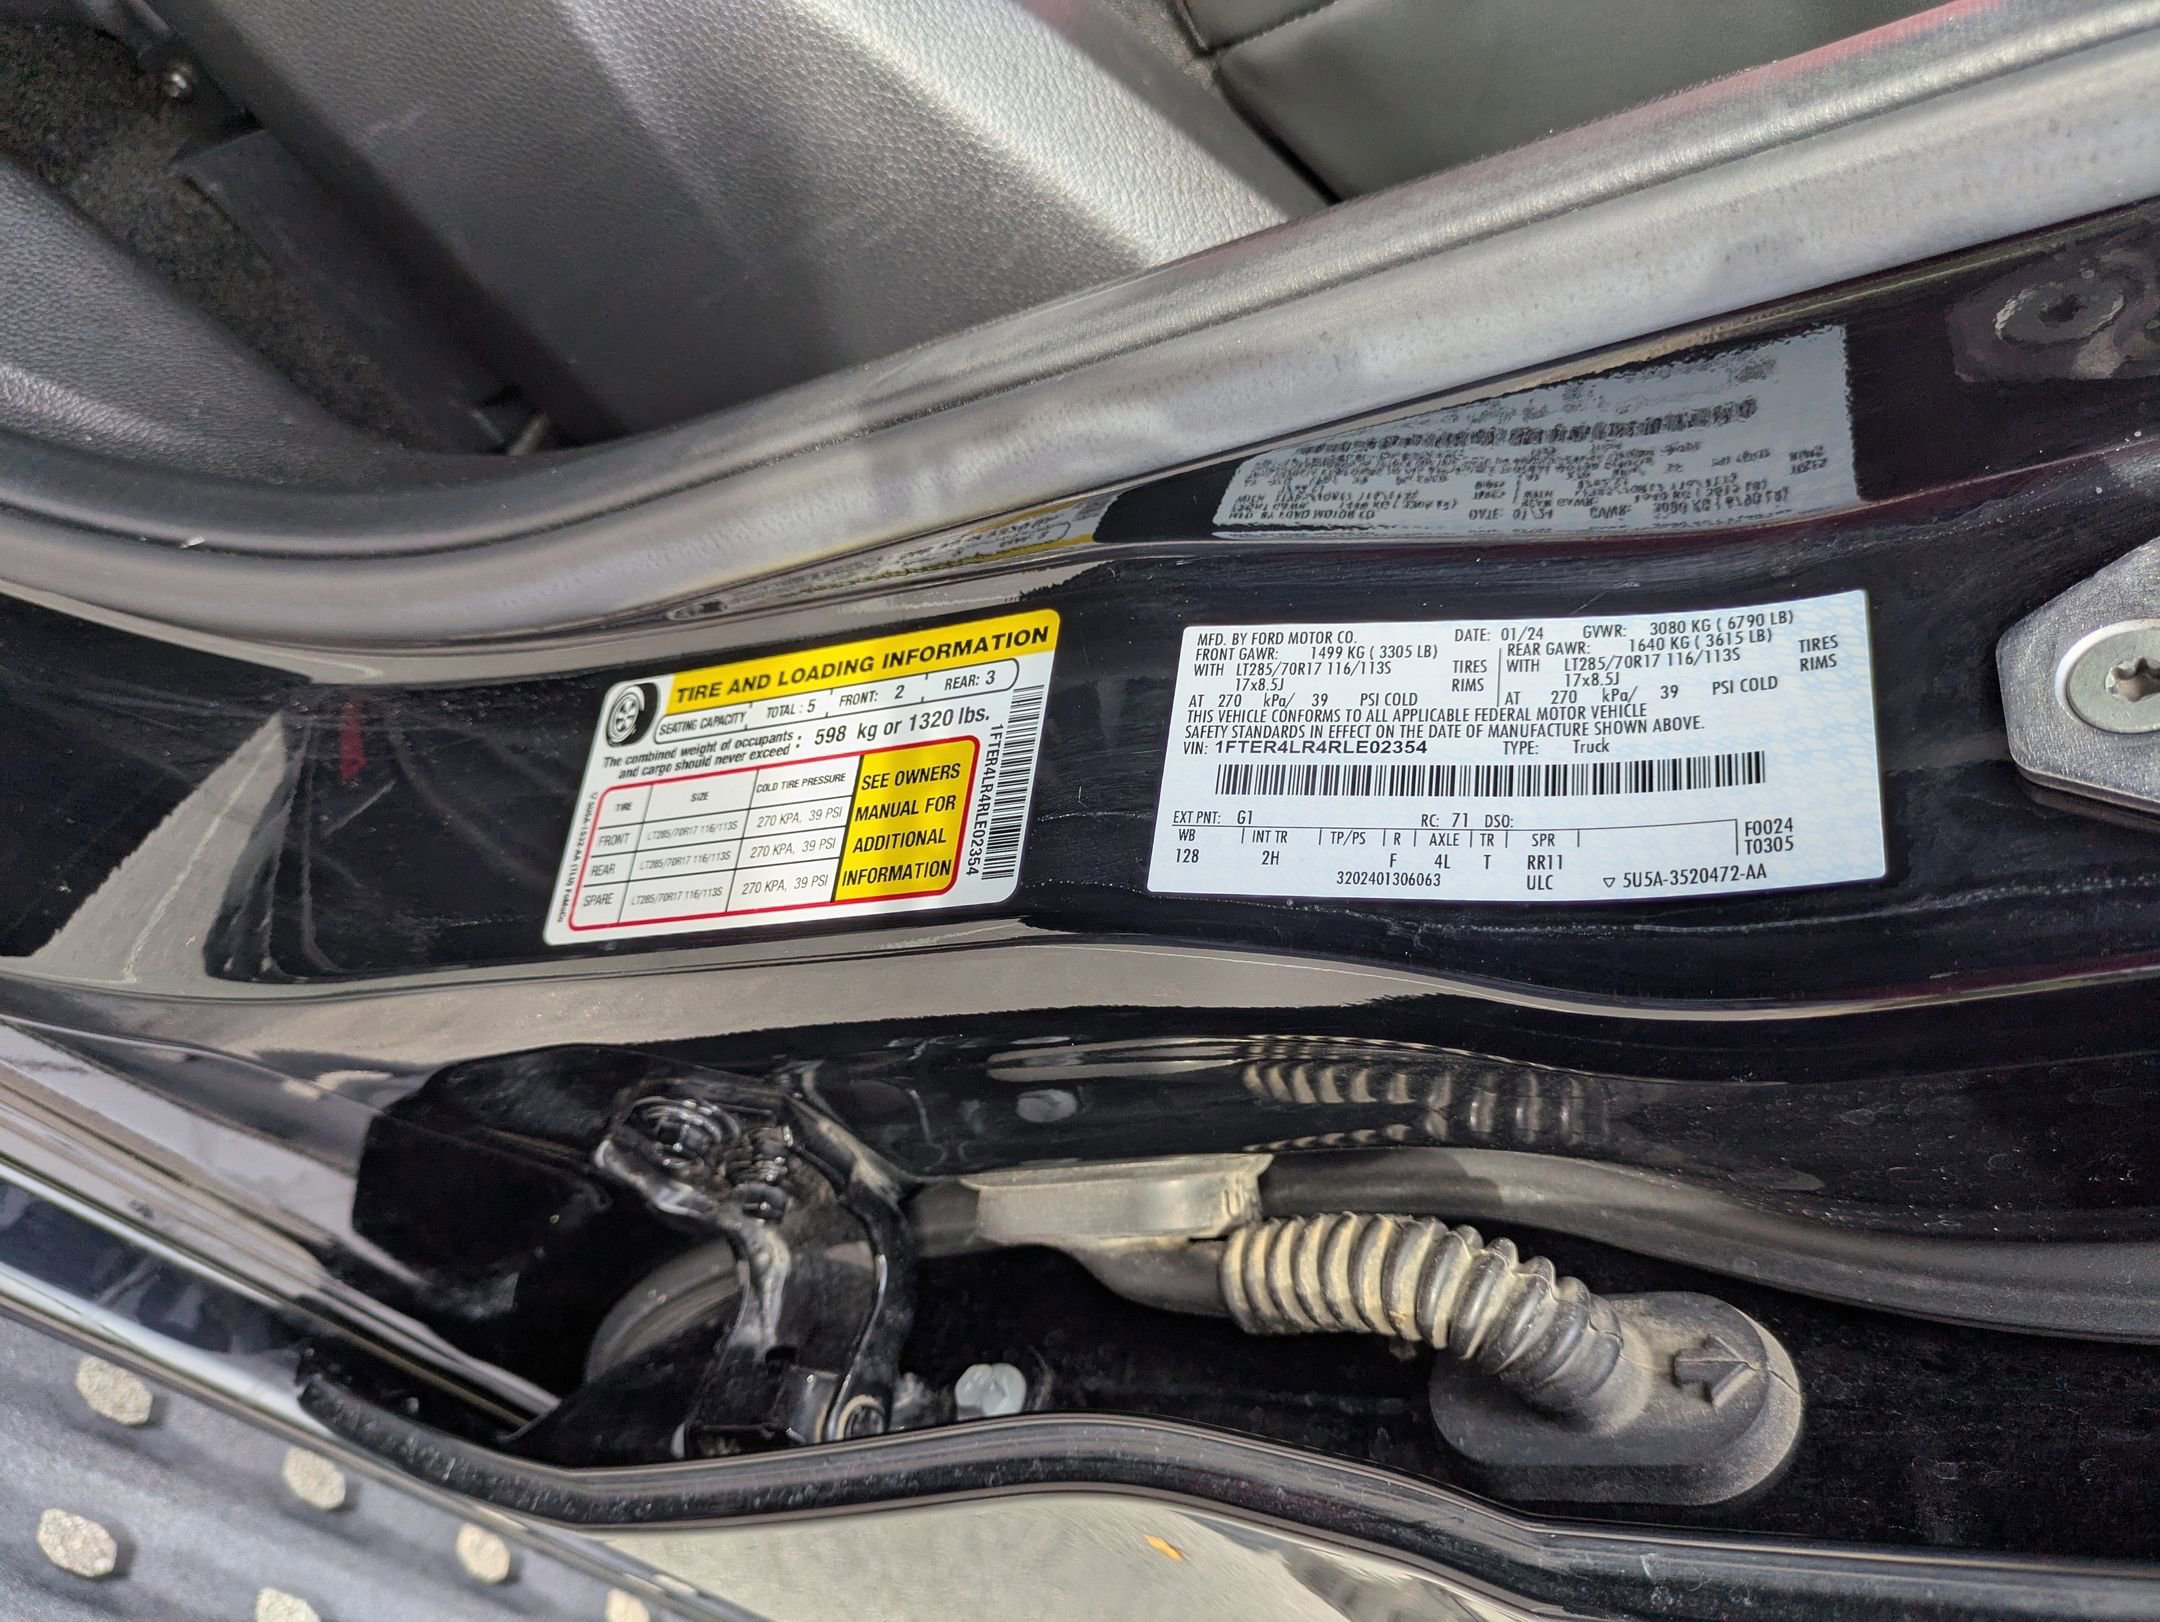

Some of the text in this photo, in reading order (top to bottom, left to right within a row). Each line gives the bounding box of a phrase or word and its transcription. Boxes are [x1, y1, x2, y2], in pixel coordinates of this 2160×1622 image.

[1583, 610, 1793, 639] GVWR: 3080 KG 6790 LB)
[1197, 631, 1357, 646] MFD. BY FORD MOTOR CO.
[1455, 626, 1544, 642] DATE: 01/24
[1507, 629, 1772, 656] REAR GAWR: 1640 KG 3615 LB)
[1798, 635, 1838, 653] TIRES
[1196, 645, 1437, 660] FRONT GAWR: 1499 KG 3305 LB)
[1506, 648, 1740, 673] WITH LT285/70R17 116/113S
[677, 626, 1049, 703] TIRE AND LOADING INFORMATION
[1194, 661, 1391, 676] WITH LT285/70R17 116/113S
[1453, 660, 1487, 673] TIRES
[1800, 654, 1837, 672] RIMS
[944, 671, 995, 690] REAR: 3
[1235, 679, 1284, 692] 17x8.5J
[1452, 678, 1484, 692] RIMS
[1564, 673, 1619, 687] 17x8.5J
[839, 685, 904, 707] FRONT: 2
[1504, 676, 1778, 705] AT 270 kPa/ 39 PSI COLD
[807, 700, 815, 713] 5
[1189, 692, 1418, 707] AT 270 kPa/ 39 PSI COLD
[1187, 704, 1646, 723] THIS VEHICLE CONFORMS TO ALL APPLICABLE FEDERAL MOTOR VEHICLE
[659, 711, 747, 735] SEATING CAPACITY
[814, 706, 989, 745] 598 kg or 1320 lbs.
[1185, 716, 1704, 739] SAFETY STANDARDS IN EFFECT ON THE DATE OF MANUFACTURE SHOWN ABOVE.
[604, 730, 793, 768] The combined weight of occupants
[1183, 739, 1428, 755] VIN: 1FTER4LR4RLE02354
[1503, 737, 1610, 755] TYPE: Truck
[618, 747, 789, 779] and cargo should never exceed
[757, 773, 845, 793] COLD TIRE PRESSURE
[862, 763, 960, 790] SEE OWNERS
[691, 792, 709, 801] SIZE
[966, 724, 1004, 876] 1FTER4LR4RLE02354
[616, 802, 632, 812] TIRE
[855, 795, 956, 822] MANUAL FOR
[757, 806, 843, 828] 270 KPA, 39 PSI
[1174, 810, 1252, 824] EXT PNT: G1
[1421, 813, 1468, 827] RC: 71
[701, 821, 738, 833] 116/113S
[1178, 829, 1195, 841] WB
[1745, 818, 1793, 836] F0024
[599, 833, 630, 846] FRONT
[853, 828, 946, 853] ADDITIONAL
[1252, 831, 1287, 843] INT TR
[1331, 831, 1366, 845] TP/PS
[1429, 833, 1459, 846] AXLE
[1480, 834, 1494, 846] TR
[1531, 834, 1555, 847] SPR
[1745, 836, 1793, 854] T0305
[750, 837, 836, 858] 270 KPA, 39 PSI
[693, 851, 731, 864] 116/113S
[1175, 849, 1199, 863] 128
[1262, 851, 1279, 865] 2H
[1434, 854, 1450, 869] 4L
[1527, 855, 1563, 870] RR11
[591, 864, 616, 876] REAR
[842, 860, 952, 886] INFORMATION
[1623, 864, 1766, 888] 5U5A-3520472-AA
[742, 874, 828, 895] 270 KPA, 39 PSI
[1336, 872, 1441, 887] 3202401306063
[1527, 875, 1553, 891] ULC
[583, 893, 614, 907] SPARE
[685, 887, 722, 900] 116/113S
